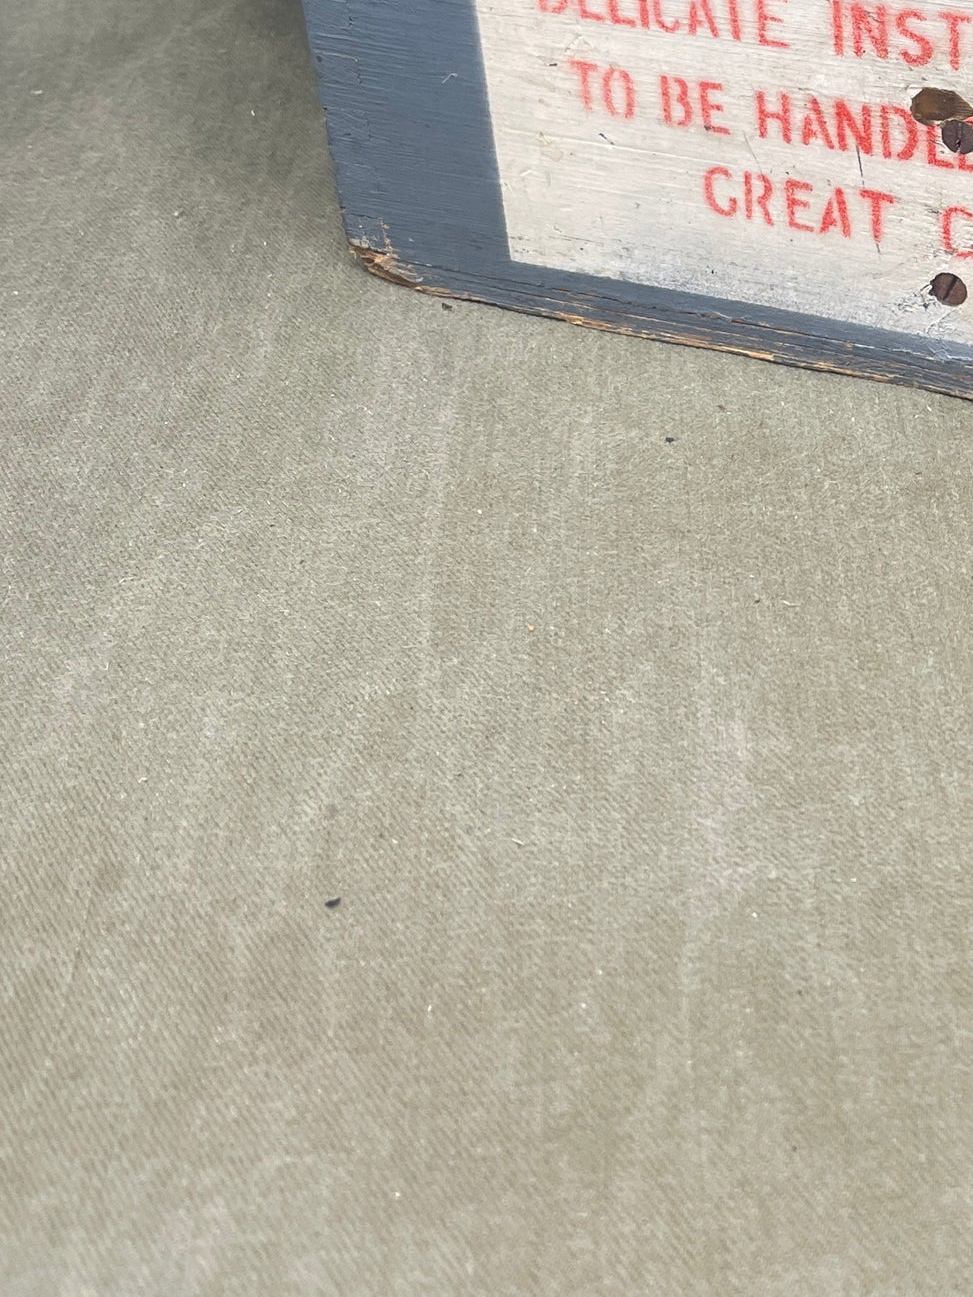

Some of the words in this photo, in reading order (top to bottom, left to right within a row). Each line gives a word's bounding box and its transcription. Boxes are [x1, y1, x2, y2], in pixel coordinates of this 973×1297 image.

[568, 60, 637, 121] TO
[659, 74, 732, 137] BE
[703, 166, 897, 244] GREAT
